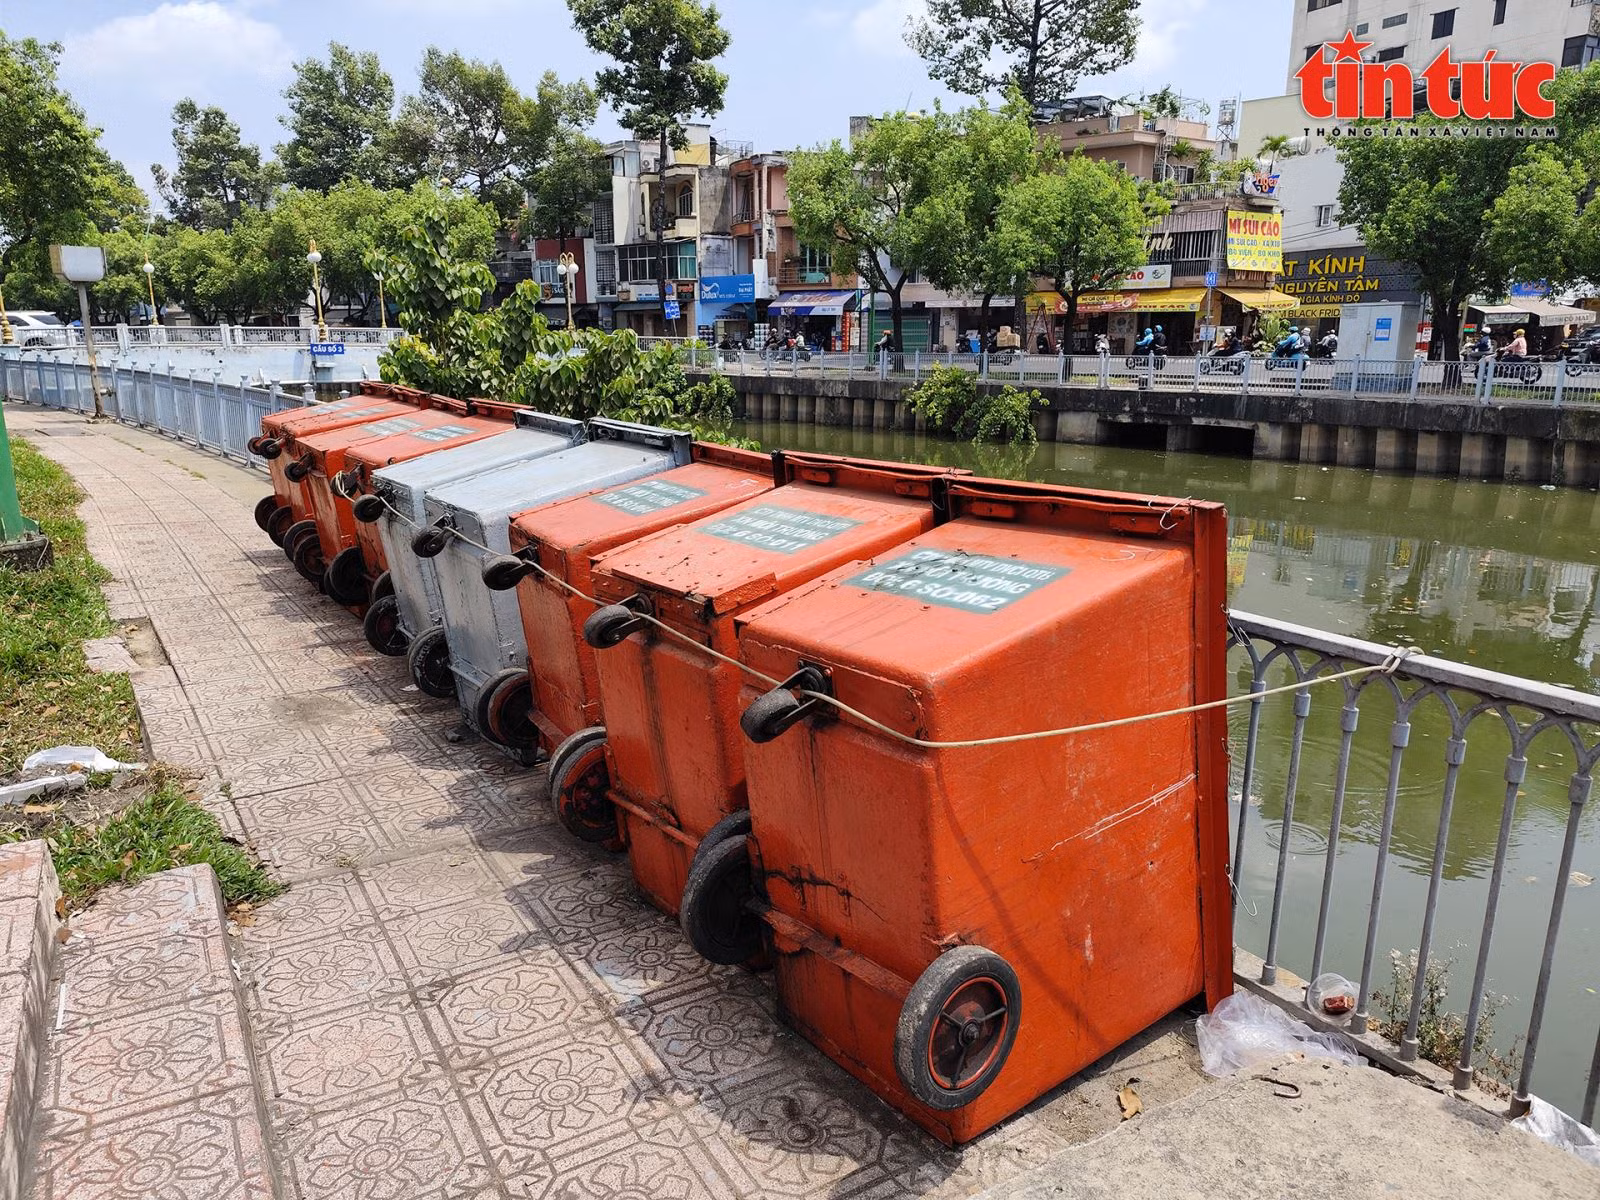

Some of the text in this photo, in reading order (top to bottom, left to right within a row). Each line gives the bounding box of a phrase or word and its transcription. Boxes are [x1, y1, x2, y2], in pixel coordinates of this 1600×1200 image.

[1308, 254, 1365, 275] KÍNH
[1274, 275, 1379, 293] NGUYÊN TÂM
[1306, 295, 1321, 303] GIA
[1322, 293, 1344, 303] KÍNH
[1288, 308, 1317, 318] BLACK
[327, 344, 337, 352] SỐ
[733, 530, 751, 538] 6
[901, 579, 923, 591] 6
